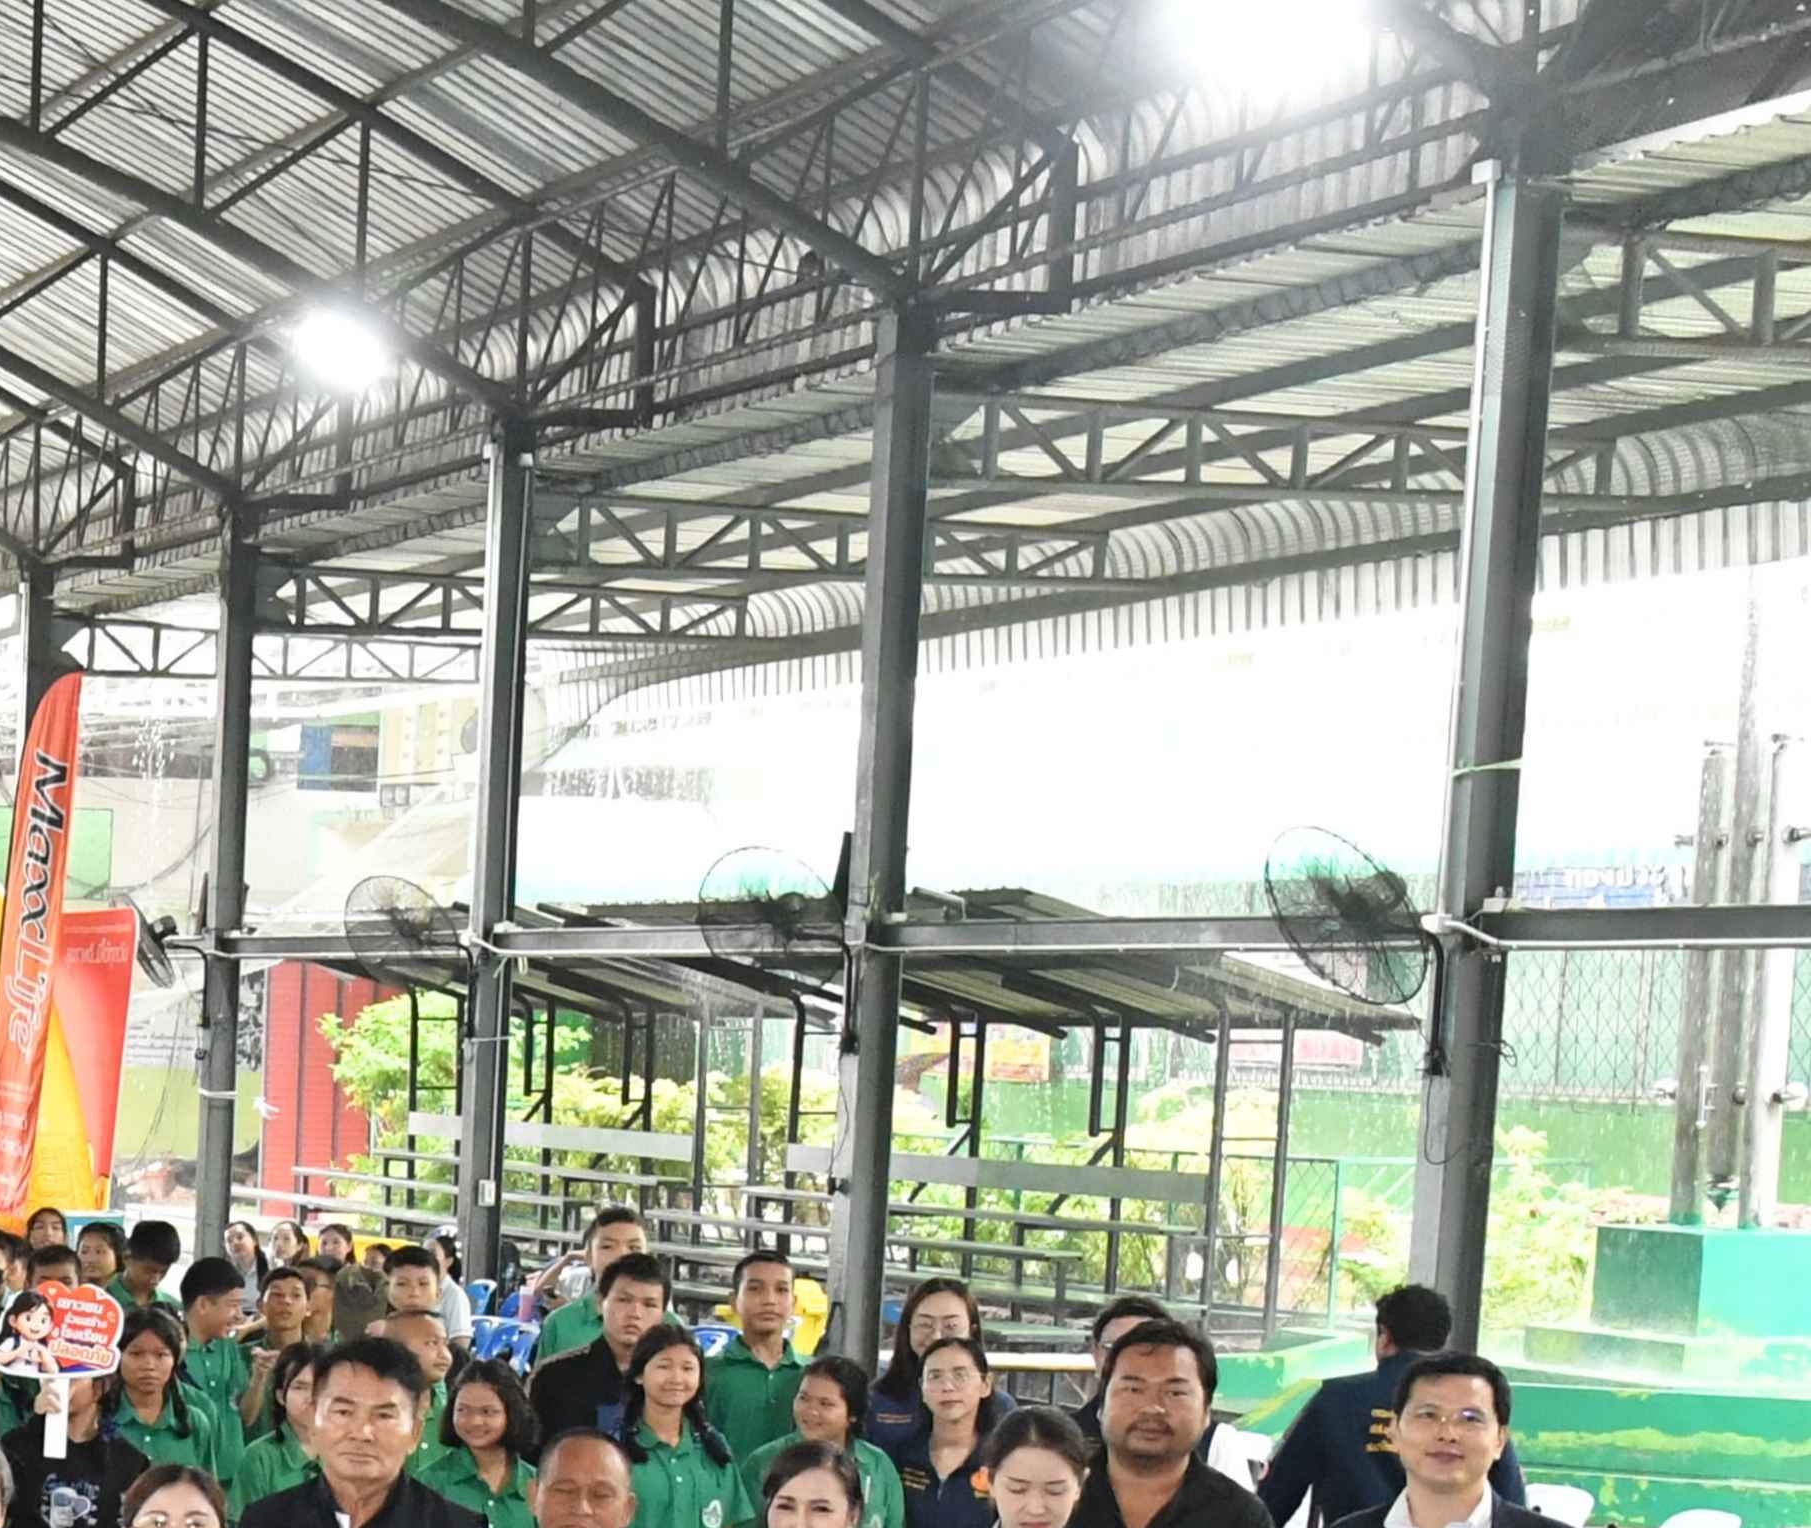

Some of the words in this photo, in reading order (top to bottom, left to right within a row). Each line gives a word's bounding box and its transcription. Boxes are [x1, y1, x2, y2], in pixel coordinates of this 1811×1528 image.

[6, 747, 70, 1062] MaxxLife
[50, 1340, 112, 1365] ปลอดภัย
